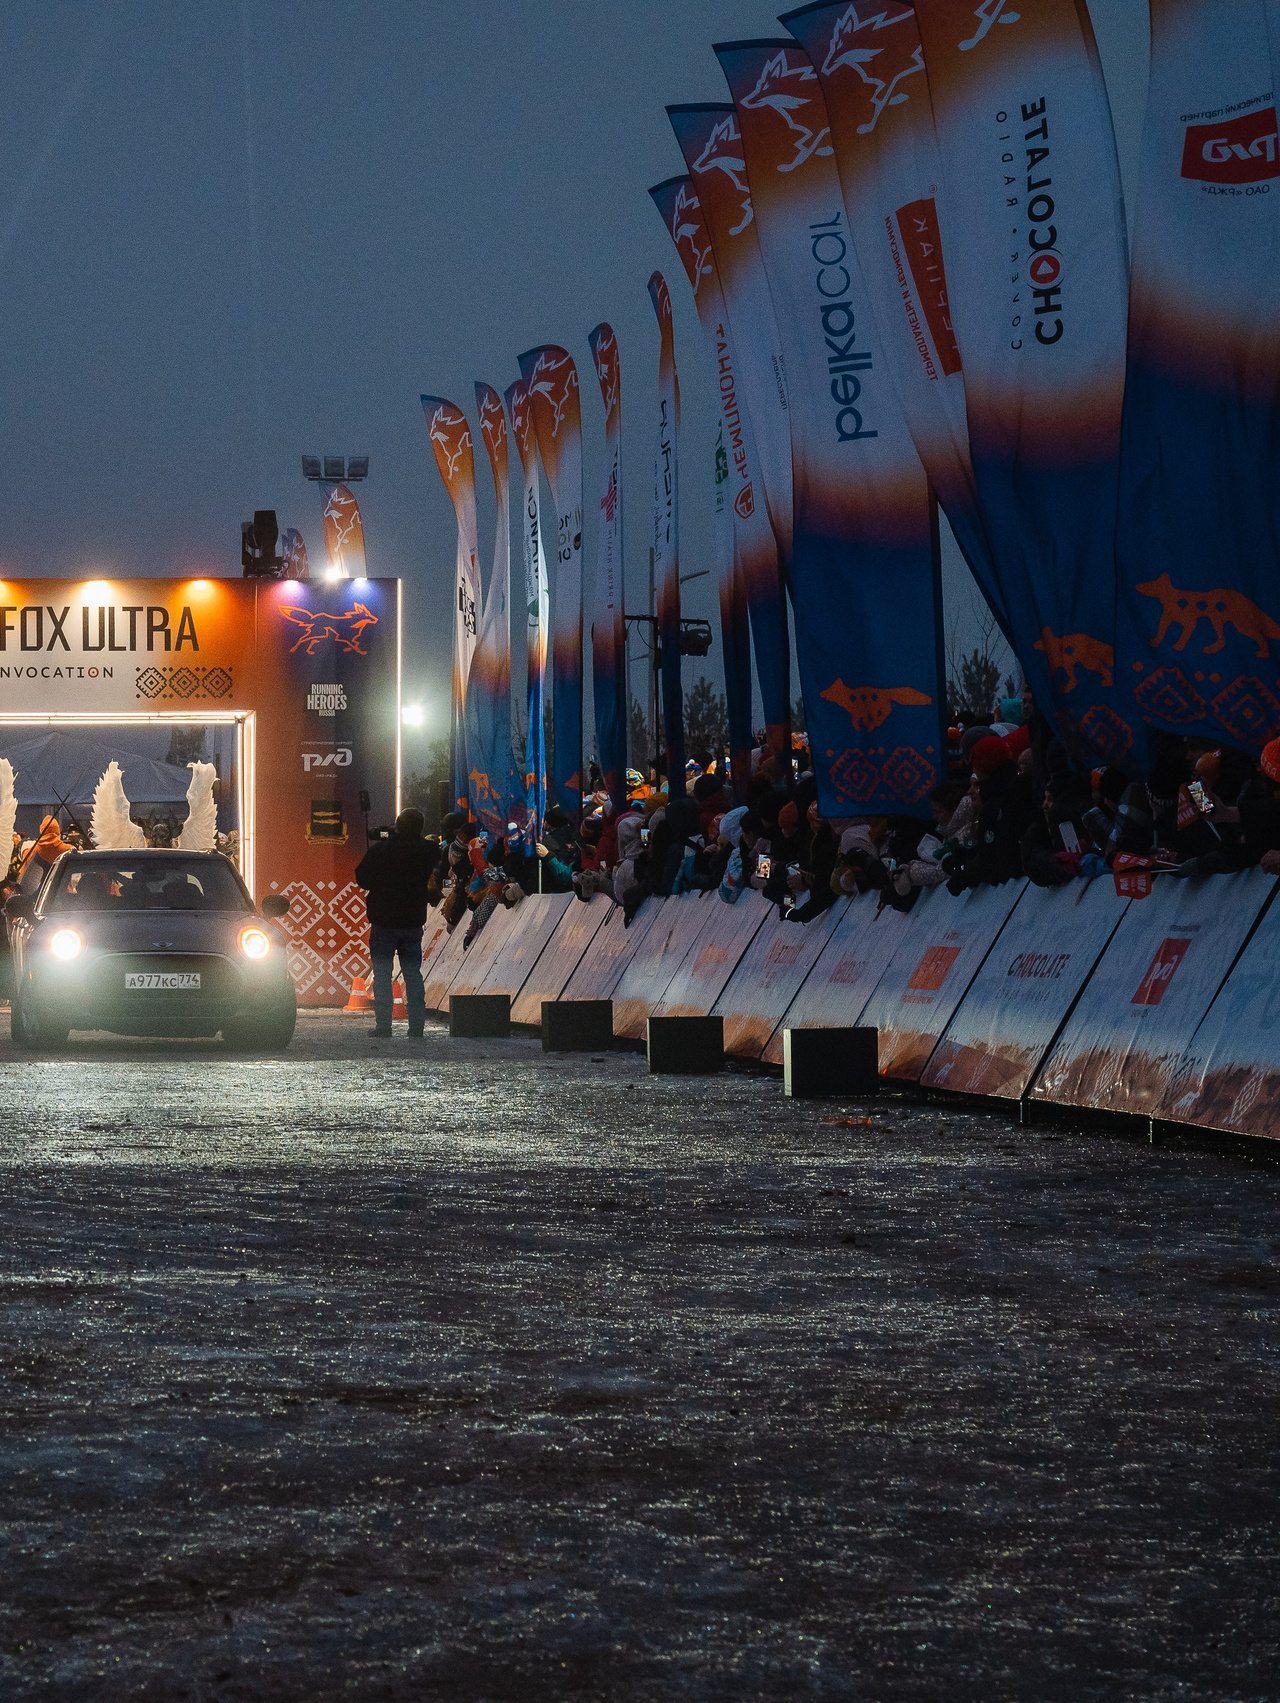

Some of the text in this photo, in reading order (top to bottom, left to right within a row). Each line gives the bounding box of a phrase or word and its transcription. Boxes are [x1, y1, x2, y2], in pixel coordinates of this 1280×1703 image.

[0, 606, 71, 651] FOX
[82, 606, 200, 651] ULTRA
[311, 683, 344, 695] RUNNING
[307, 695, 348, 710] HEROES
[179, 974, 200, 985] 774
